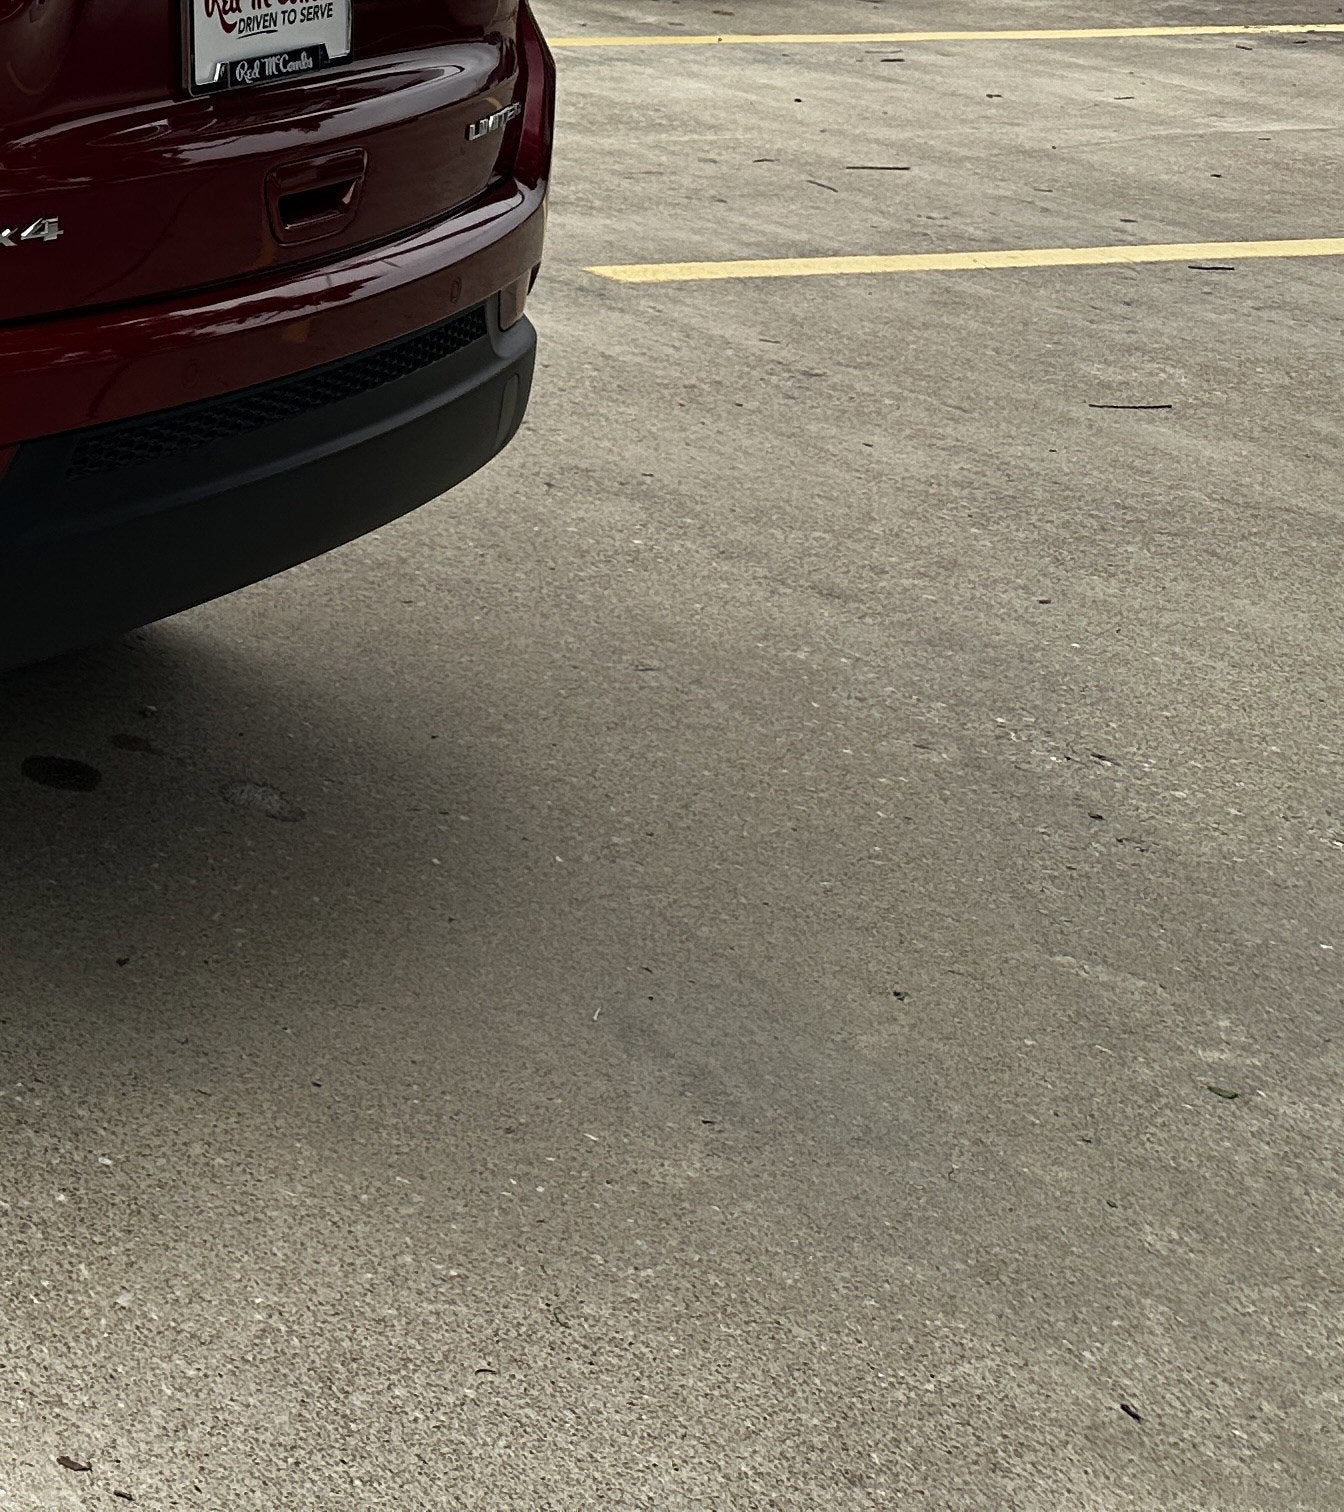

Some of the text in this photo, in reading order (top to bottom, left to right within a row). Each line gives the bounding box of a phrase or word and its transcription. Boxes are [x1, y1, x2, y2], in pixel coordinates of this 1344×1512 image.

[237, 2, 334, 35] DRIVEN TO SERVE
[235, 51, 313, 83] Red McCombs
